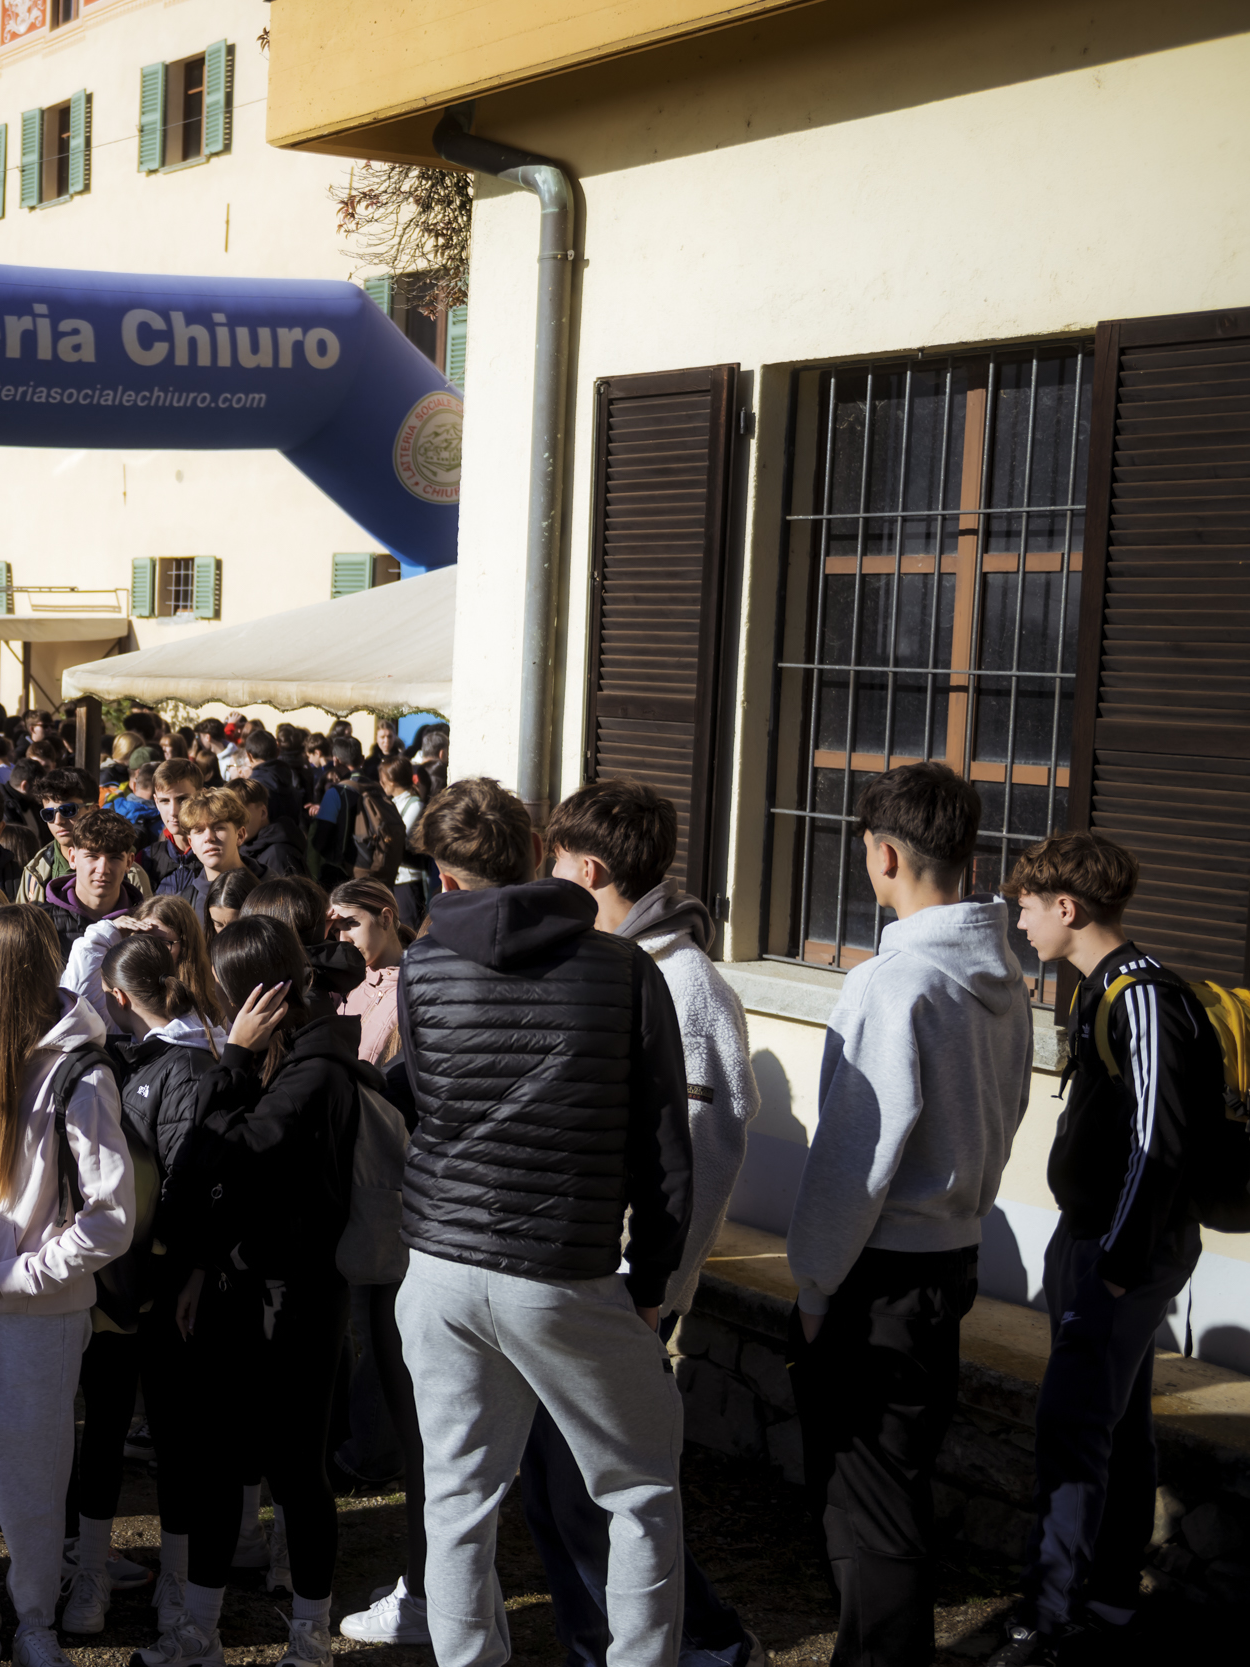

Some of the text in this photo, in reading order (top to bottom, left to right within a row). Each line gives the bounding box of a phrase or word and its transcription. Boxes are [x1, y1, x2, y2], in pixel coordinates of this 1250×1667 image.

[121, 308, 340, 370] Chiuro
[400, 398, 452, 480] LATTERIA SOCIALE
